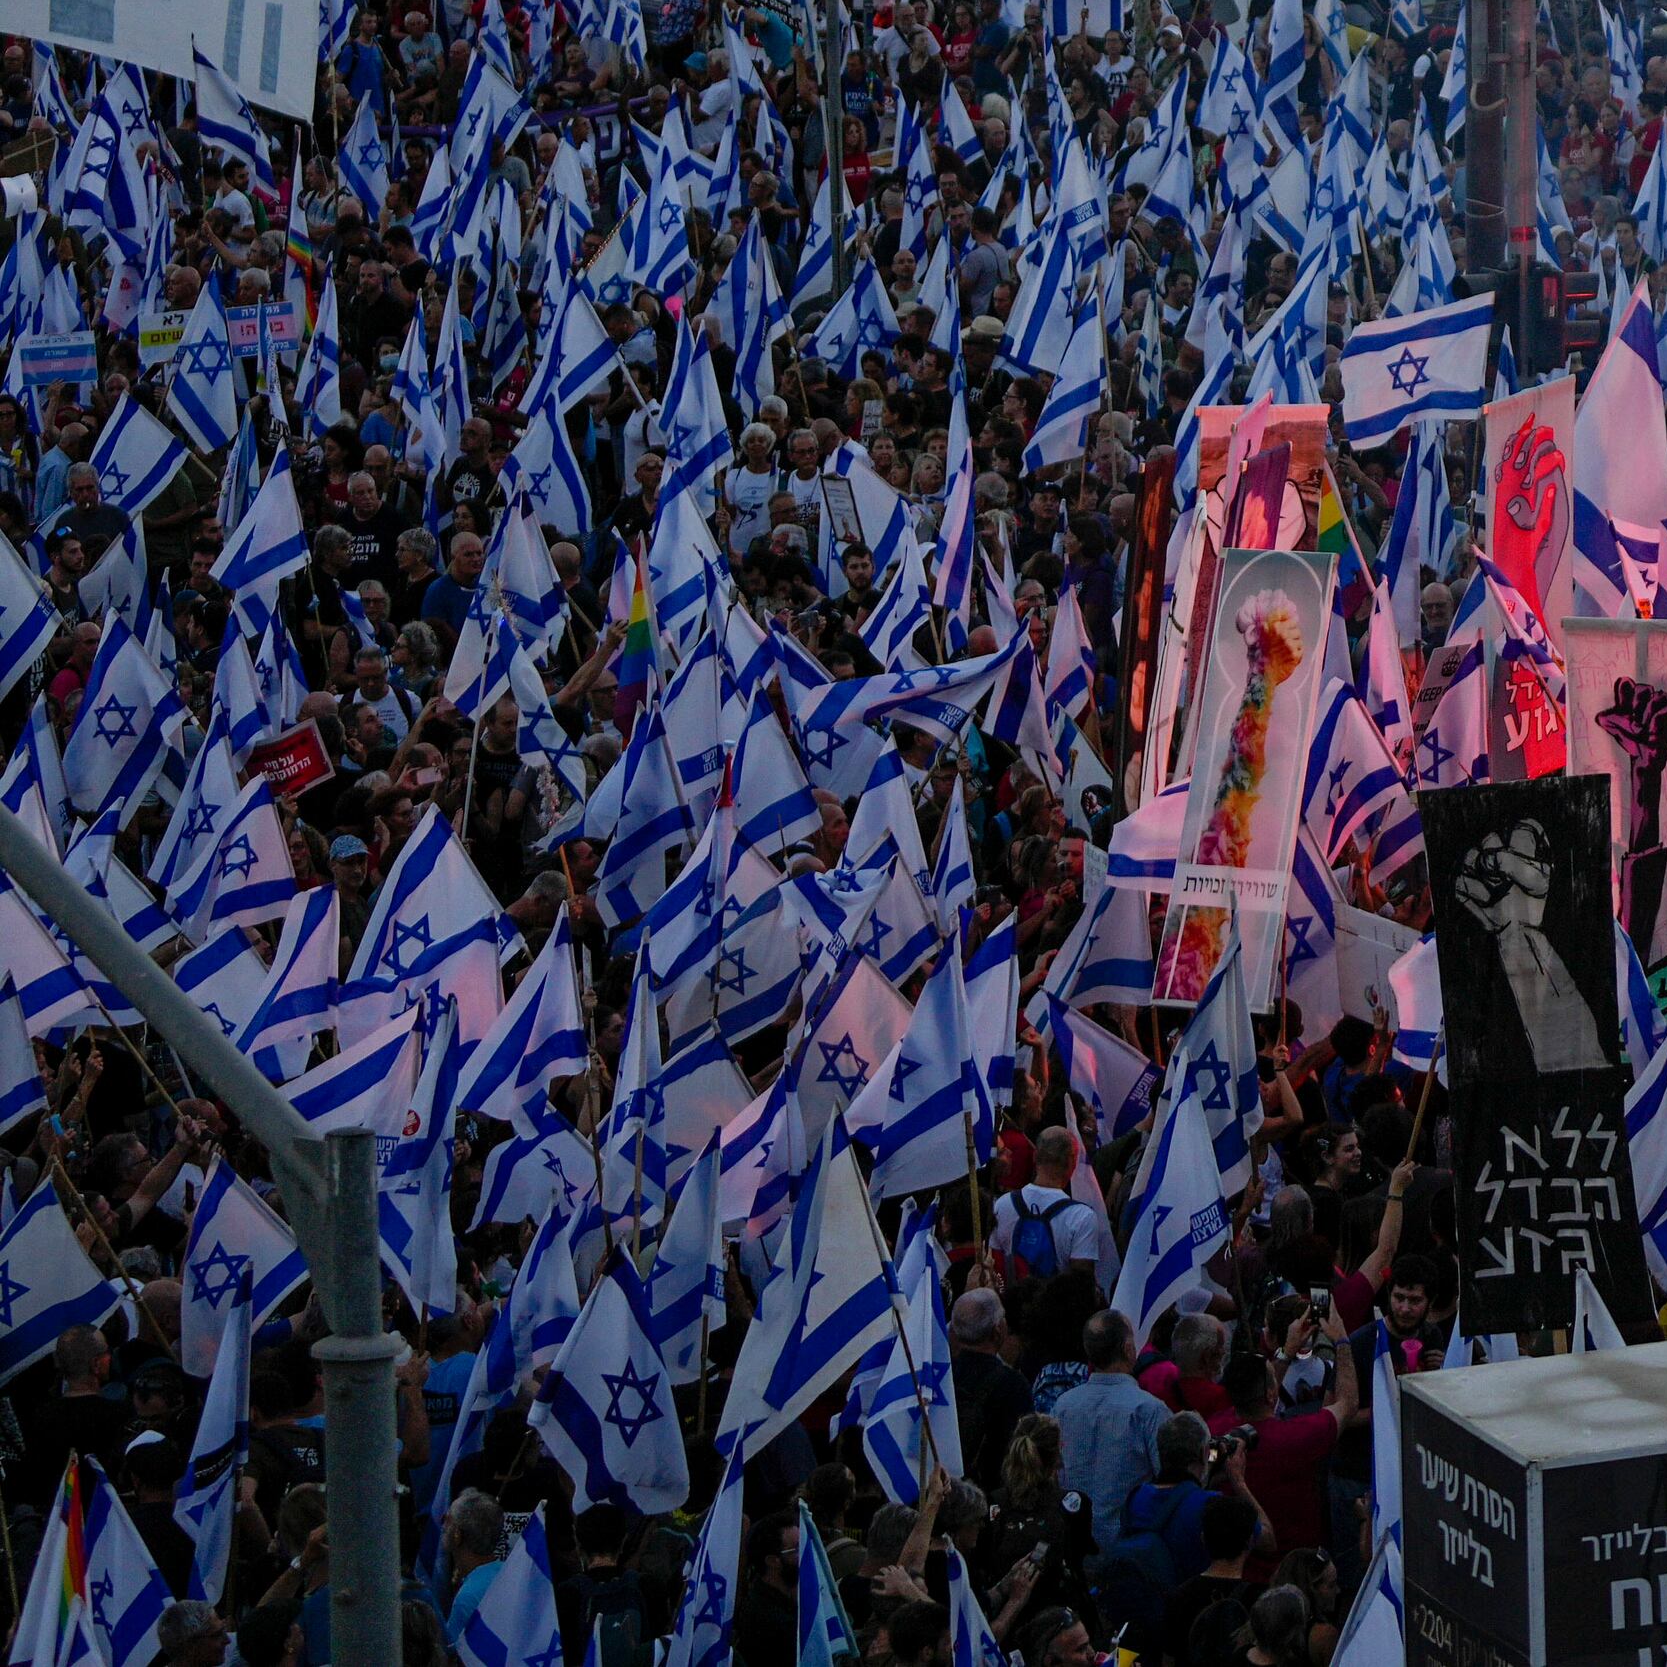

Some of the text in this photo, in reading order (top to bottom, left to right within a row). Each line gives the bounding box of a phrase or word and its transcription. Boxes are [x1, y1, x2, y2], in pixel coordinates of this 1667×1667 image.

[162, 314, 184, 327] לא
[1416, 685, 1443, 703] KEEP
[1182, 876, 1225, 894] זכויות
[1500, 1106, 1618, 1172] ללא
[1474, 1160, 1622, 1224] הבדל
[1415, 1442, 1517, 1541] הסרת שיער
[1437, 1519, 1494, 1590] בלייזר
